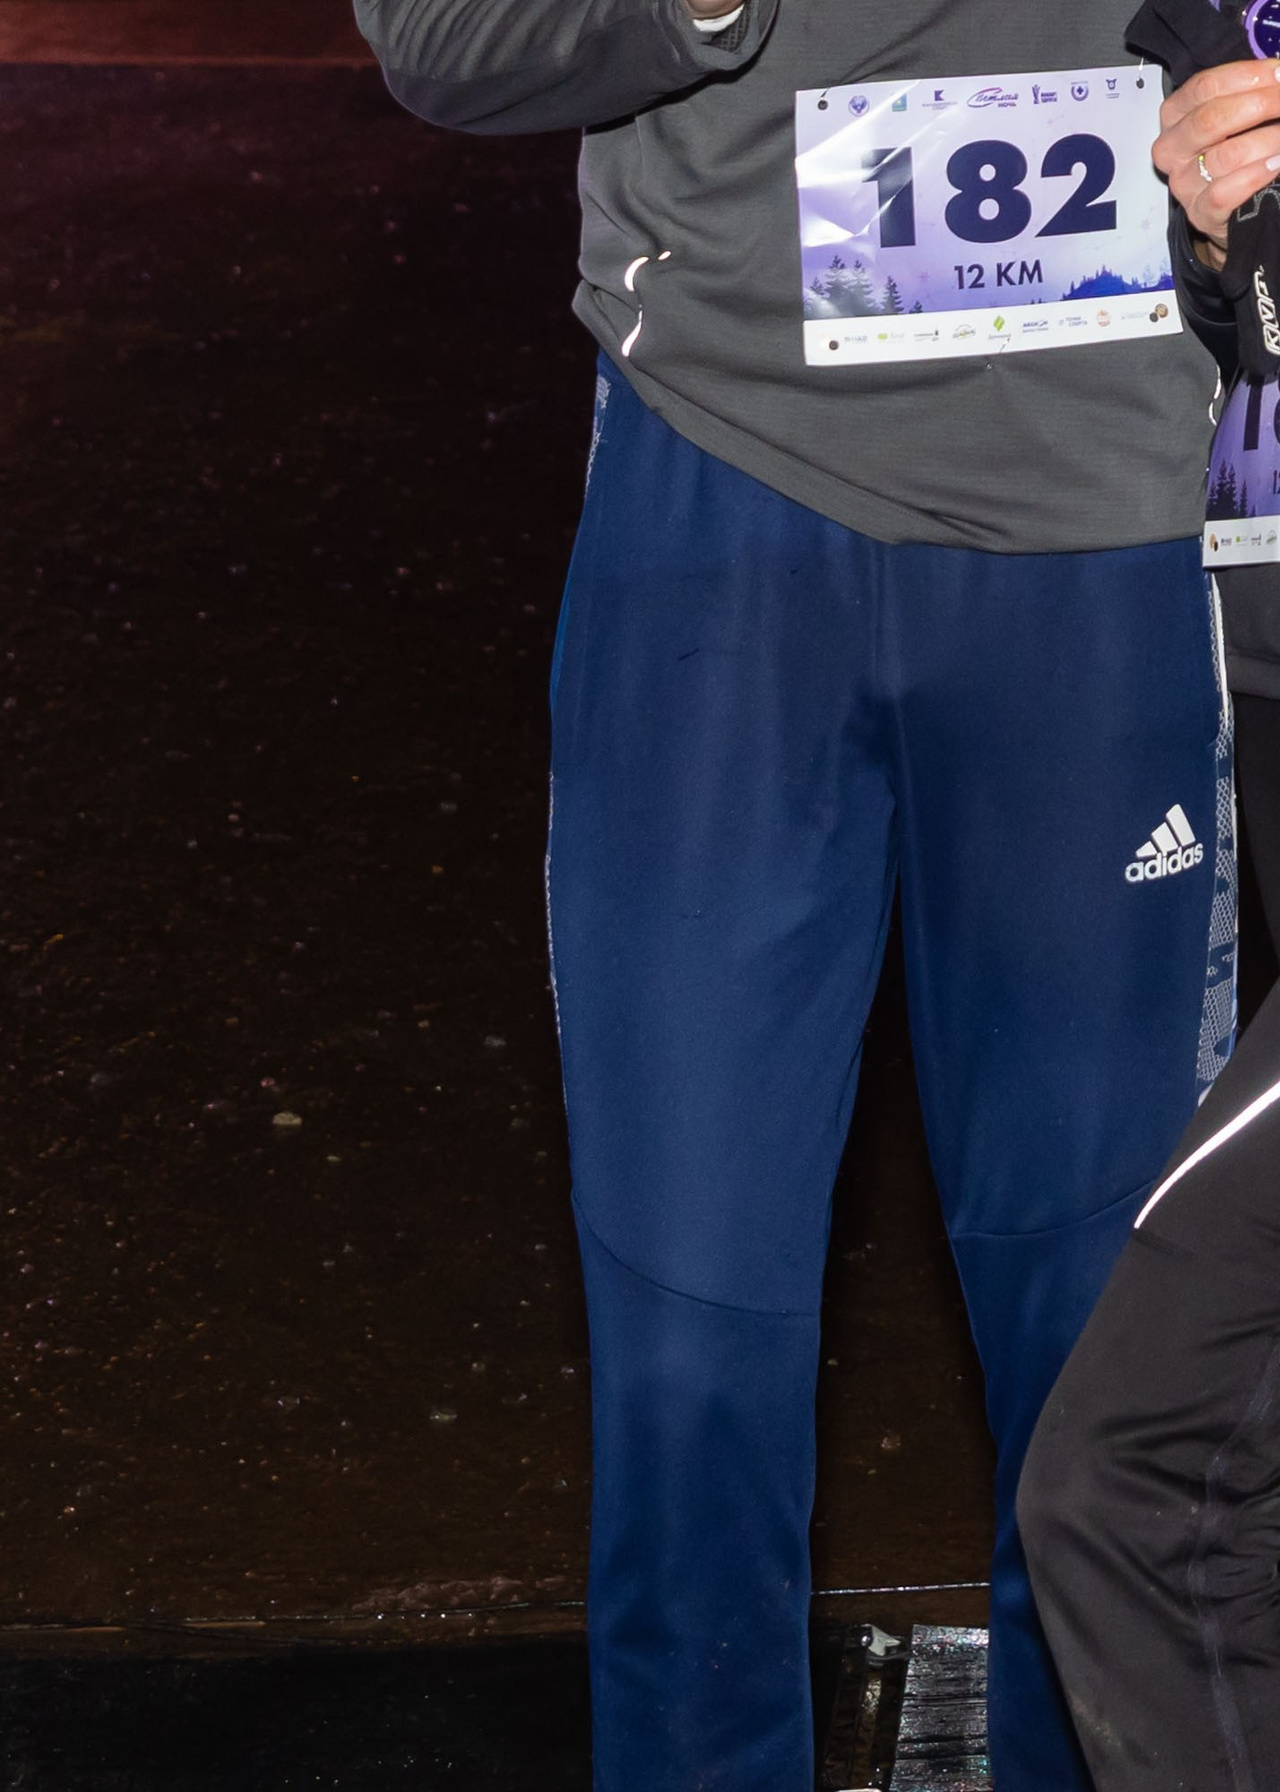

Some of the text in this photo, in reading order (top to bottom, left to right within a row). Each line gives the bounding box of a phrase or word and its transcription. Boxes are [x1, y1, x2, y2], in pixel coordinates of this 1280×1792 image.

[861, 132, 1117, 248] 182
[954, 264, 985, 290] 12
[1125, 843, 1203, 882] adidas
